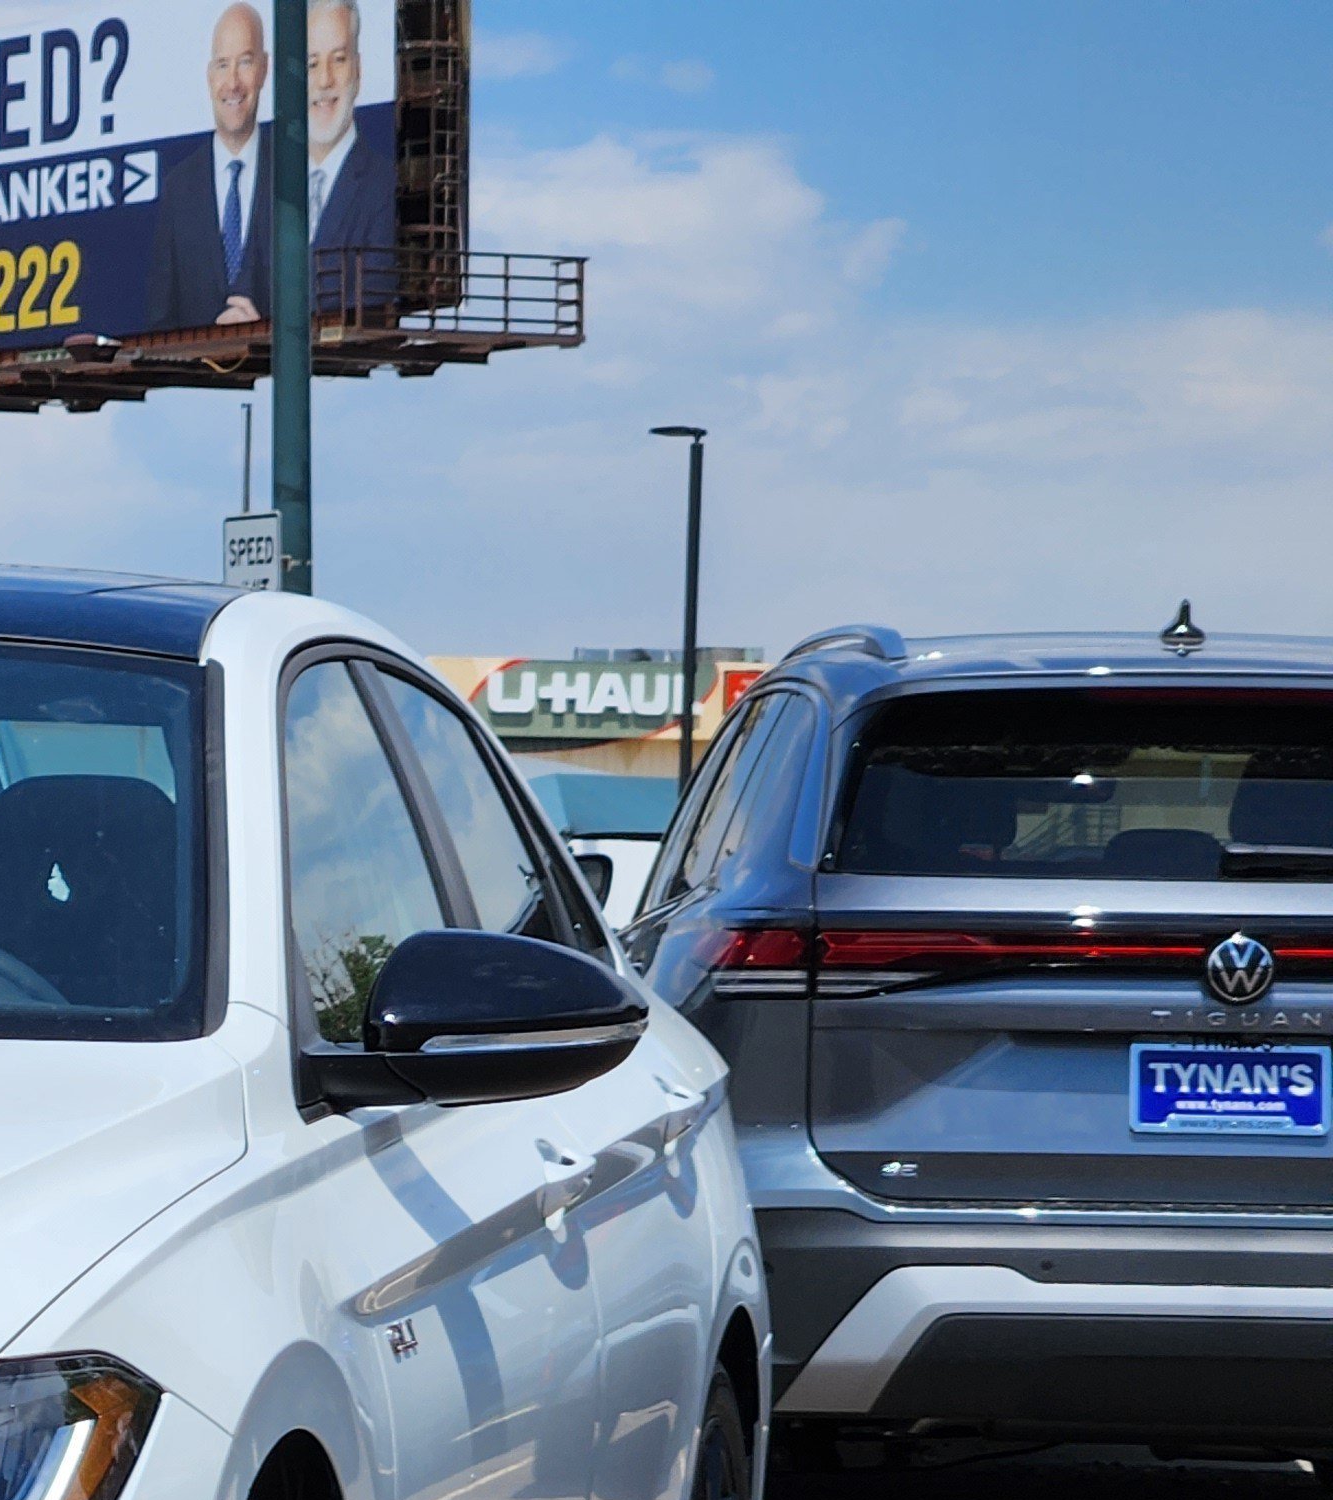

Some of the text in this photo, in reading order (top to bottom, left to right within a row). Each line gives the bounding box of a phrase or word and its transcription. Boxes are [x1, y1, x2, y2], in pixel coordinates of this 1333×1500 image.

[229, 536, 273, 568] SPEED
[487, 671, 703, 716] U-HAUL
[1150, 1010, 1323, 1027] TIGUAN
[1148, 1062, 1315, 1097] TYNAN'S
